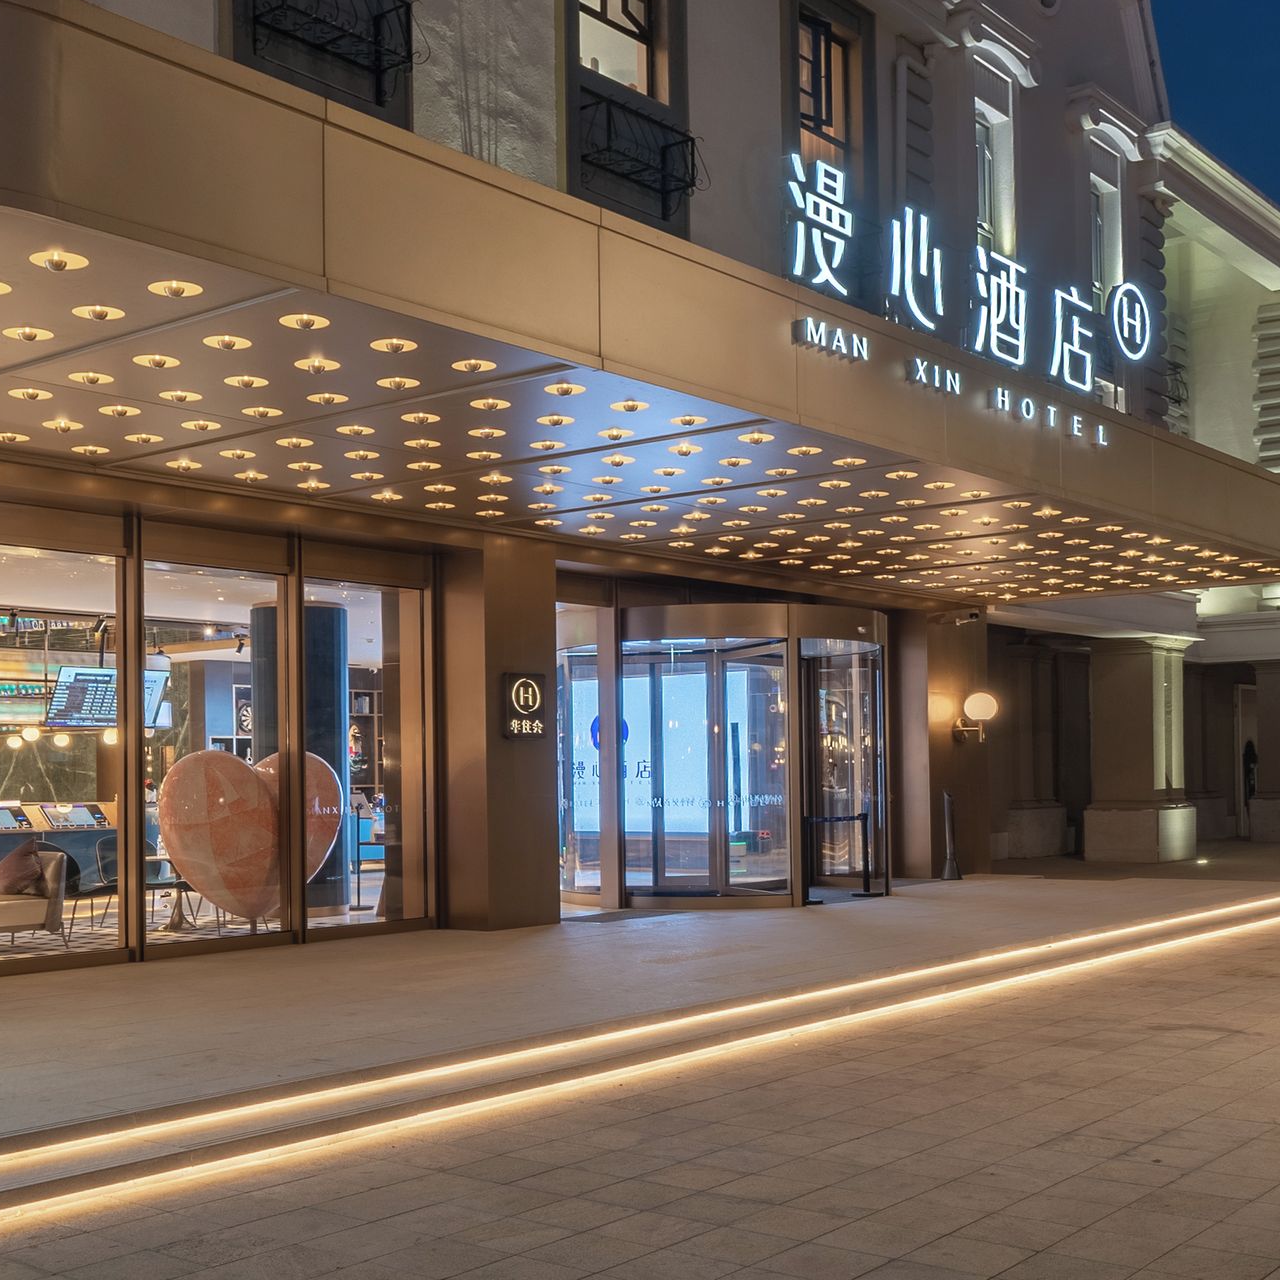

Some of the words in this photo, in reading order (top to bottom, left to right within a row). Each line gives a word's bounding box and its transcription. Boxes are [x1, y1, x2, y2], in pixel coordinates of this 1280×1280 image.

[788, 153, 1093, 393] 漫心酒店
[806, 317, 869, 361] MAN
[915, 358, 961, 395] XIN
[997, 387, 1108, 447] HOTEL
